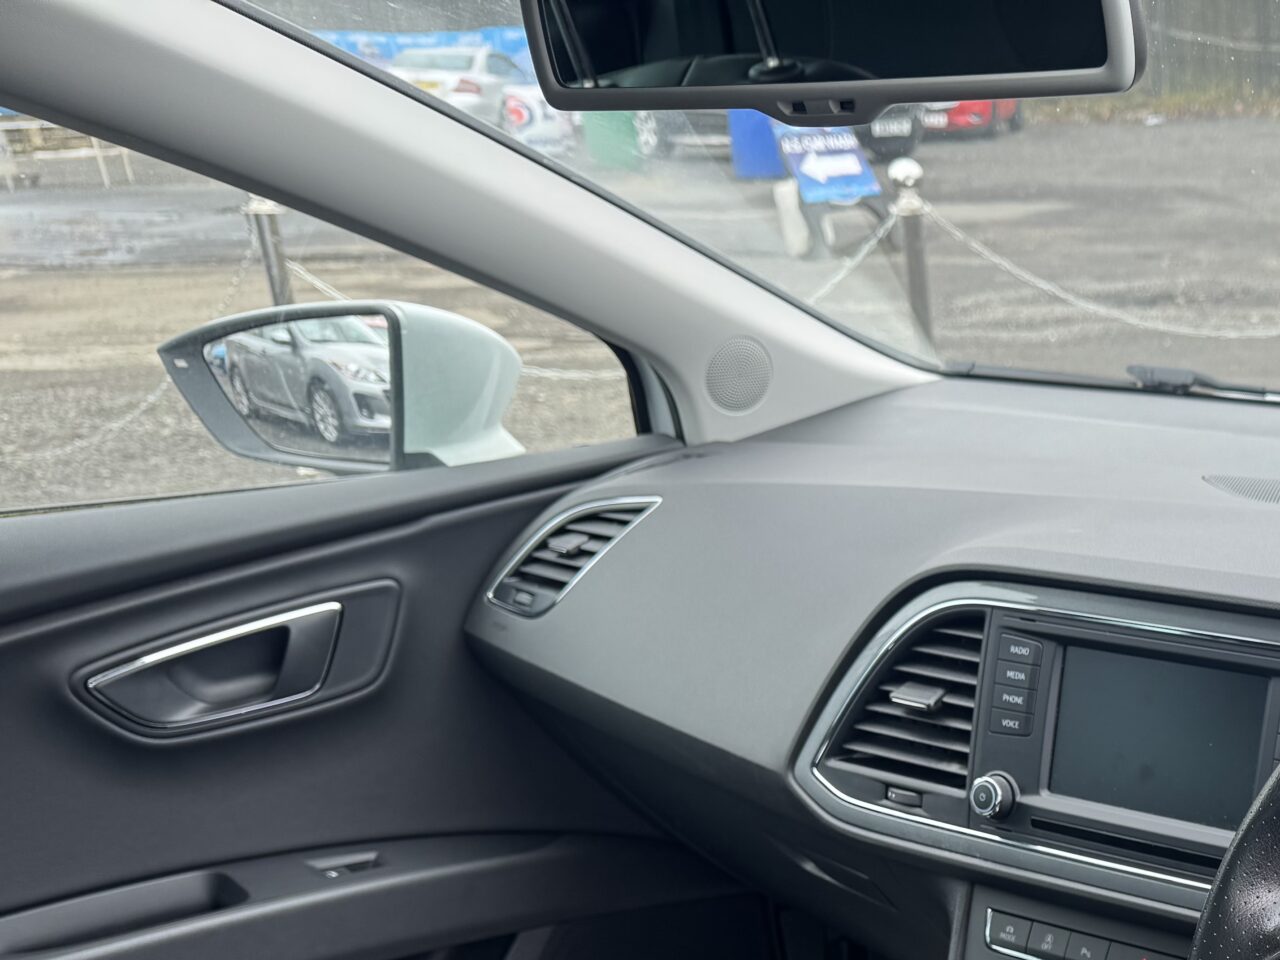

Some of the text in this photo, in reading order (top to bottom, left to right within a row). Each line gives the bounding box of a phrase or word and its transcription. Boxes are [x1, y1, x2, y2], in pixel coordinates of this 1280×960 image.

[1010, 645, 1030, 656] RADIO
[1006, 670, 1026, 681] MEDIA
[1002, 693, 1024, 705] PHONE
[1001, 719, 1020, 729] VOICE
